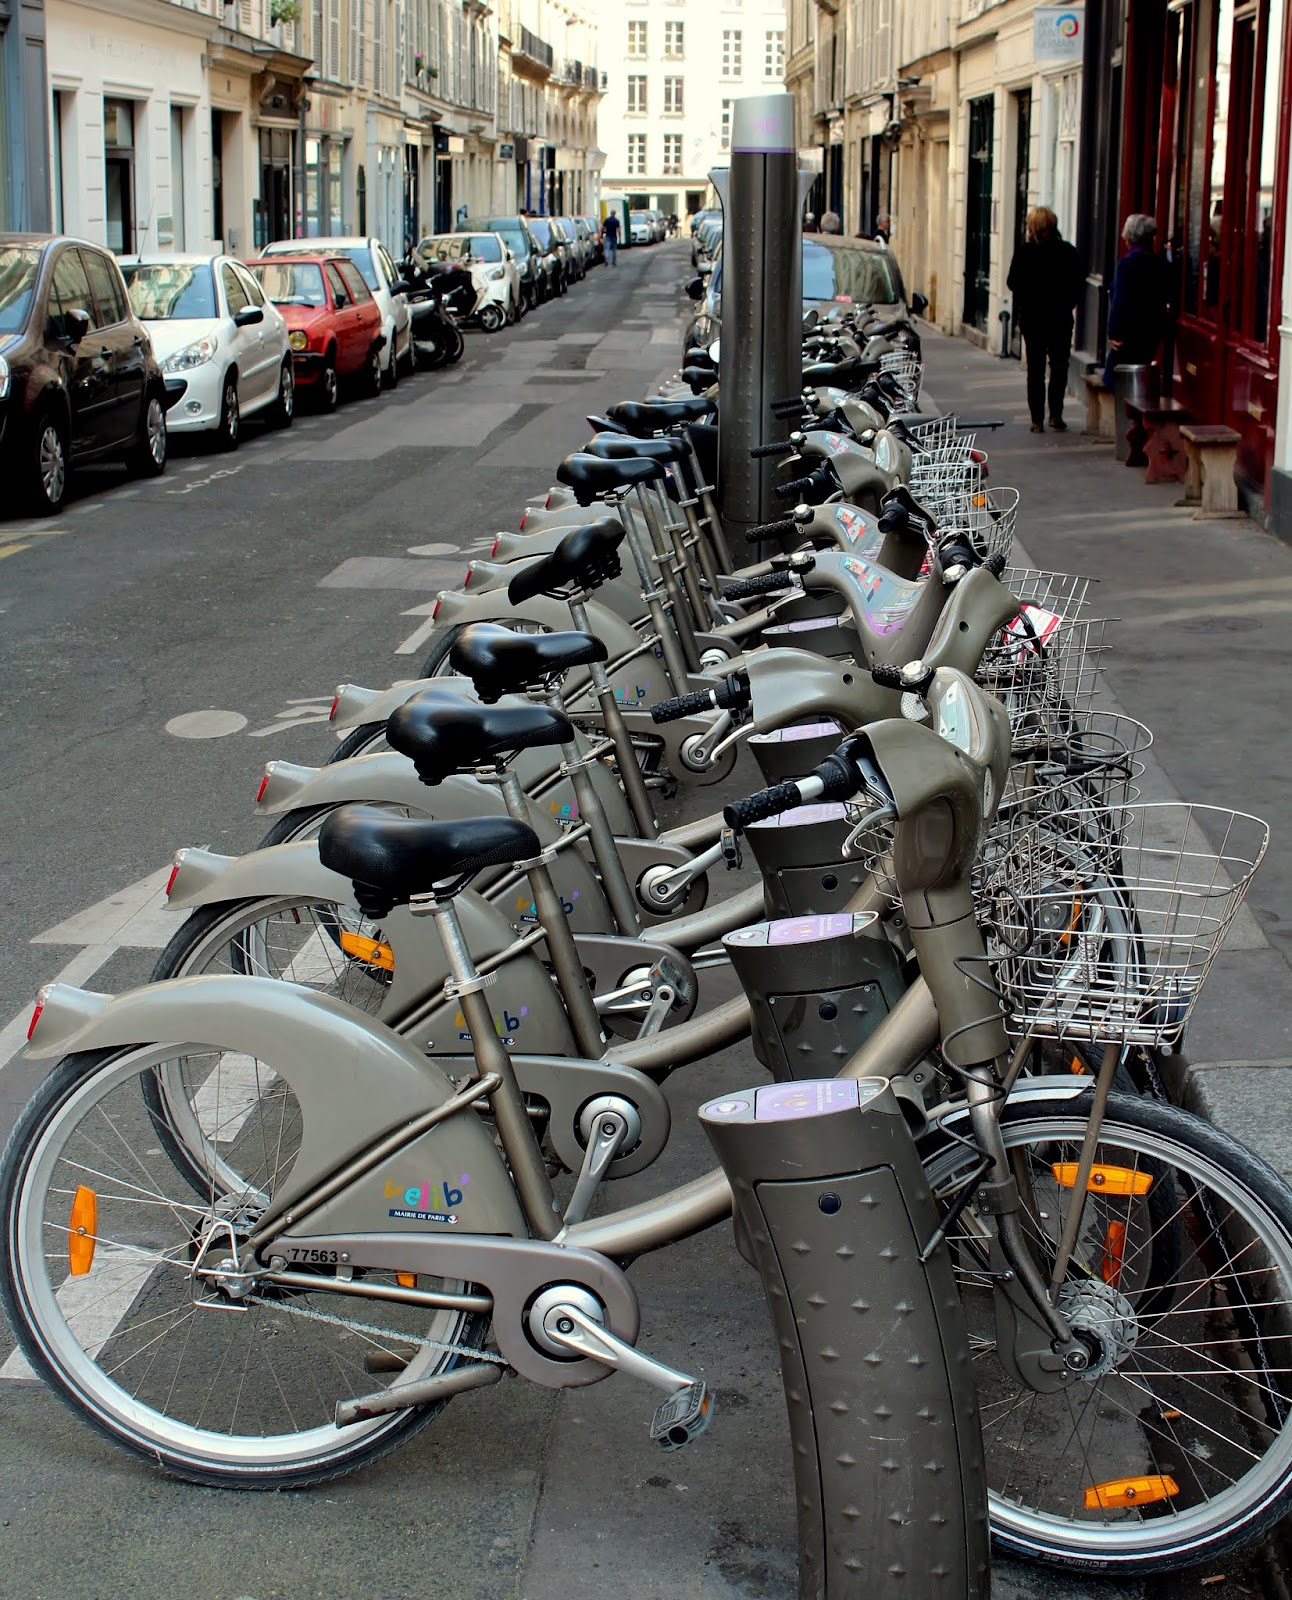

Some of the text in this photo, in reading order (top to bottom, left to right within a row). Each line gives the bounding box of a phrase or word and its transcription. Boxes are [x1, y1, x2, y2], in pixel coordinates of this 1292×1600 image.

[394, 1210, 446, 1221] MAIRIE DE PARIS
[1042, 1553, 1109, 1568] SCHWALBE
